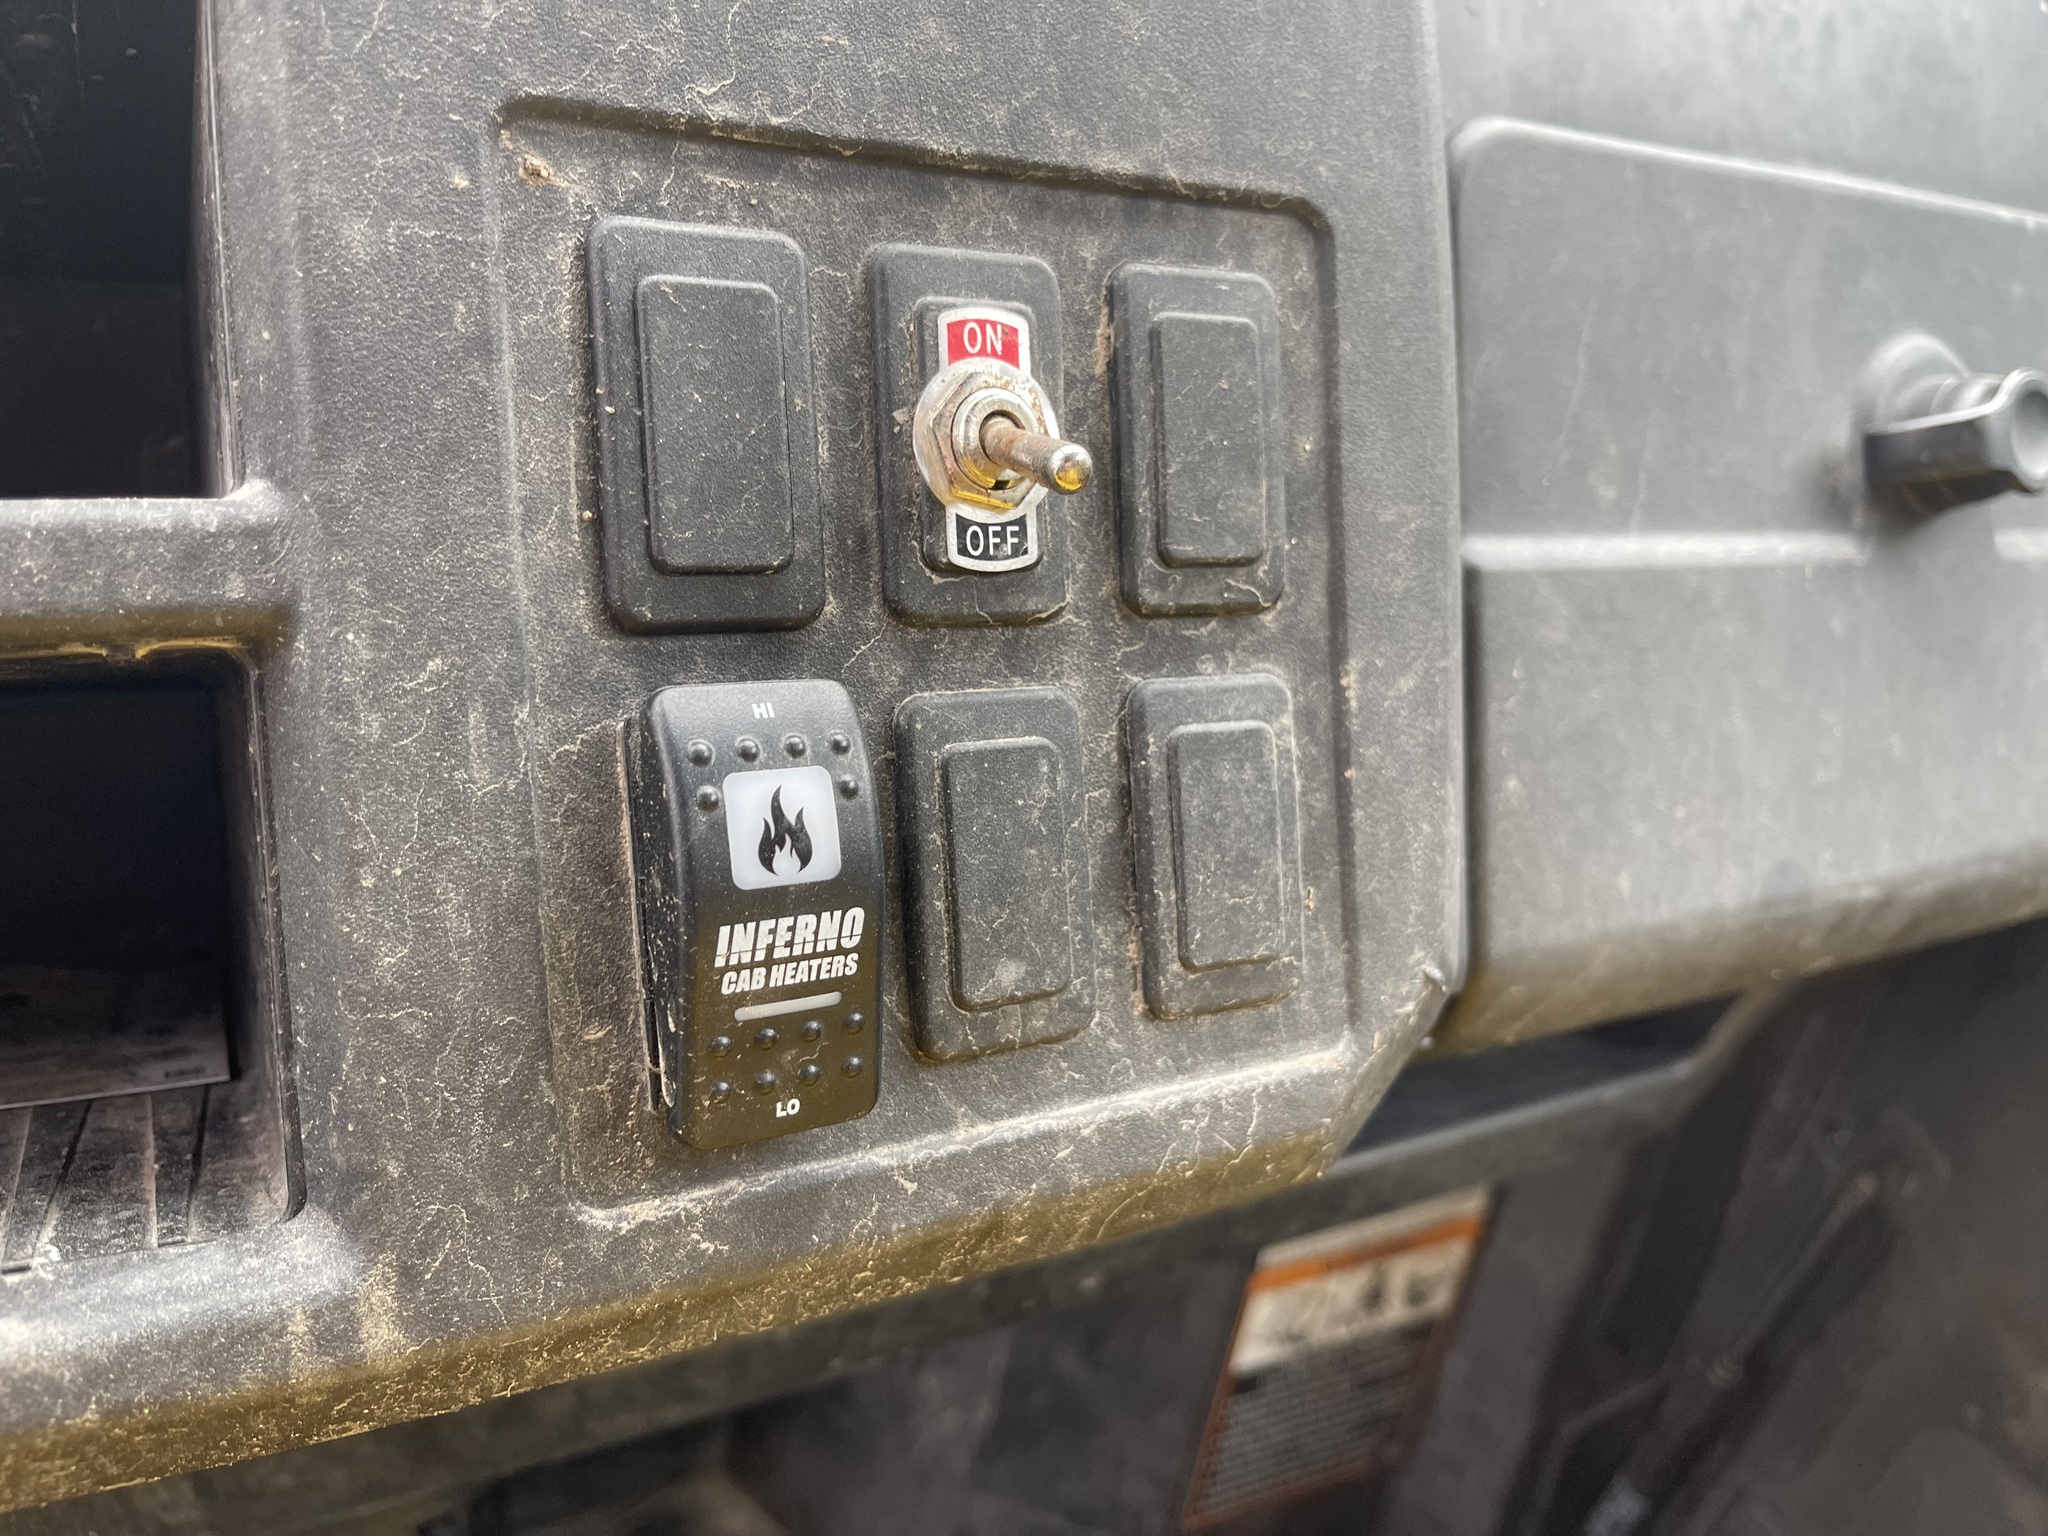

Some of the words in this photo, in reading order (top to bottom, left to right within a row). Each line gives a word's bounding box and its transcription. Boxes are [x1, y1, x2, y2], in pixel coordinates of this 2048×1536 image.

[963, 321, 1003, 356] ON
[966, 525, 1020, 556] OFF
[751, 703, 775, 719] HI
[714, 907, 865, 968] INFERNO
[721, 968, 767, 995] CAB
[769, 952, 859, 988] HEATERS
[776, 1098, 801, 1118] LO
